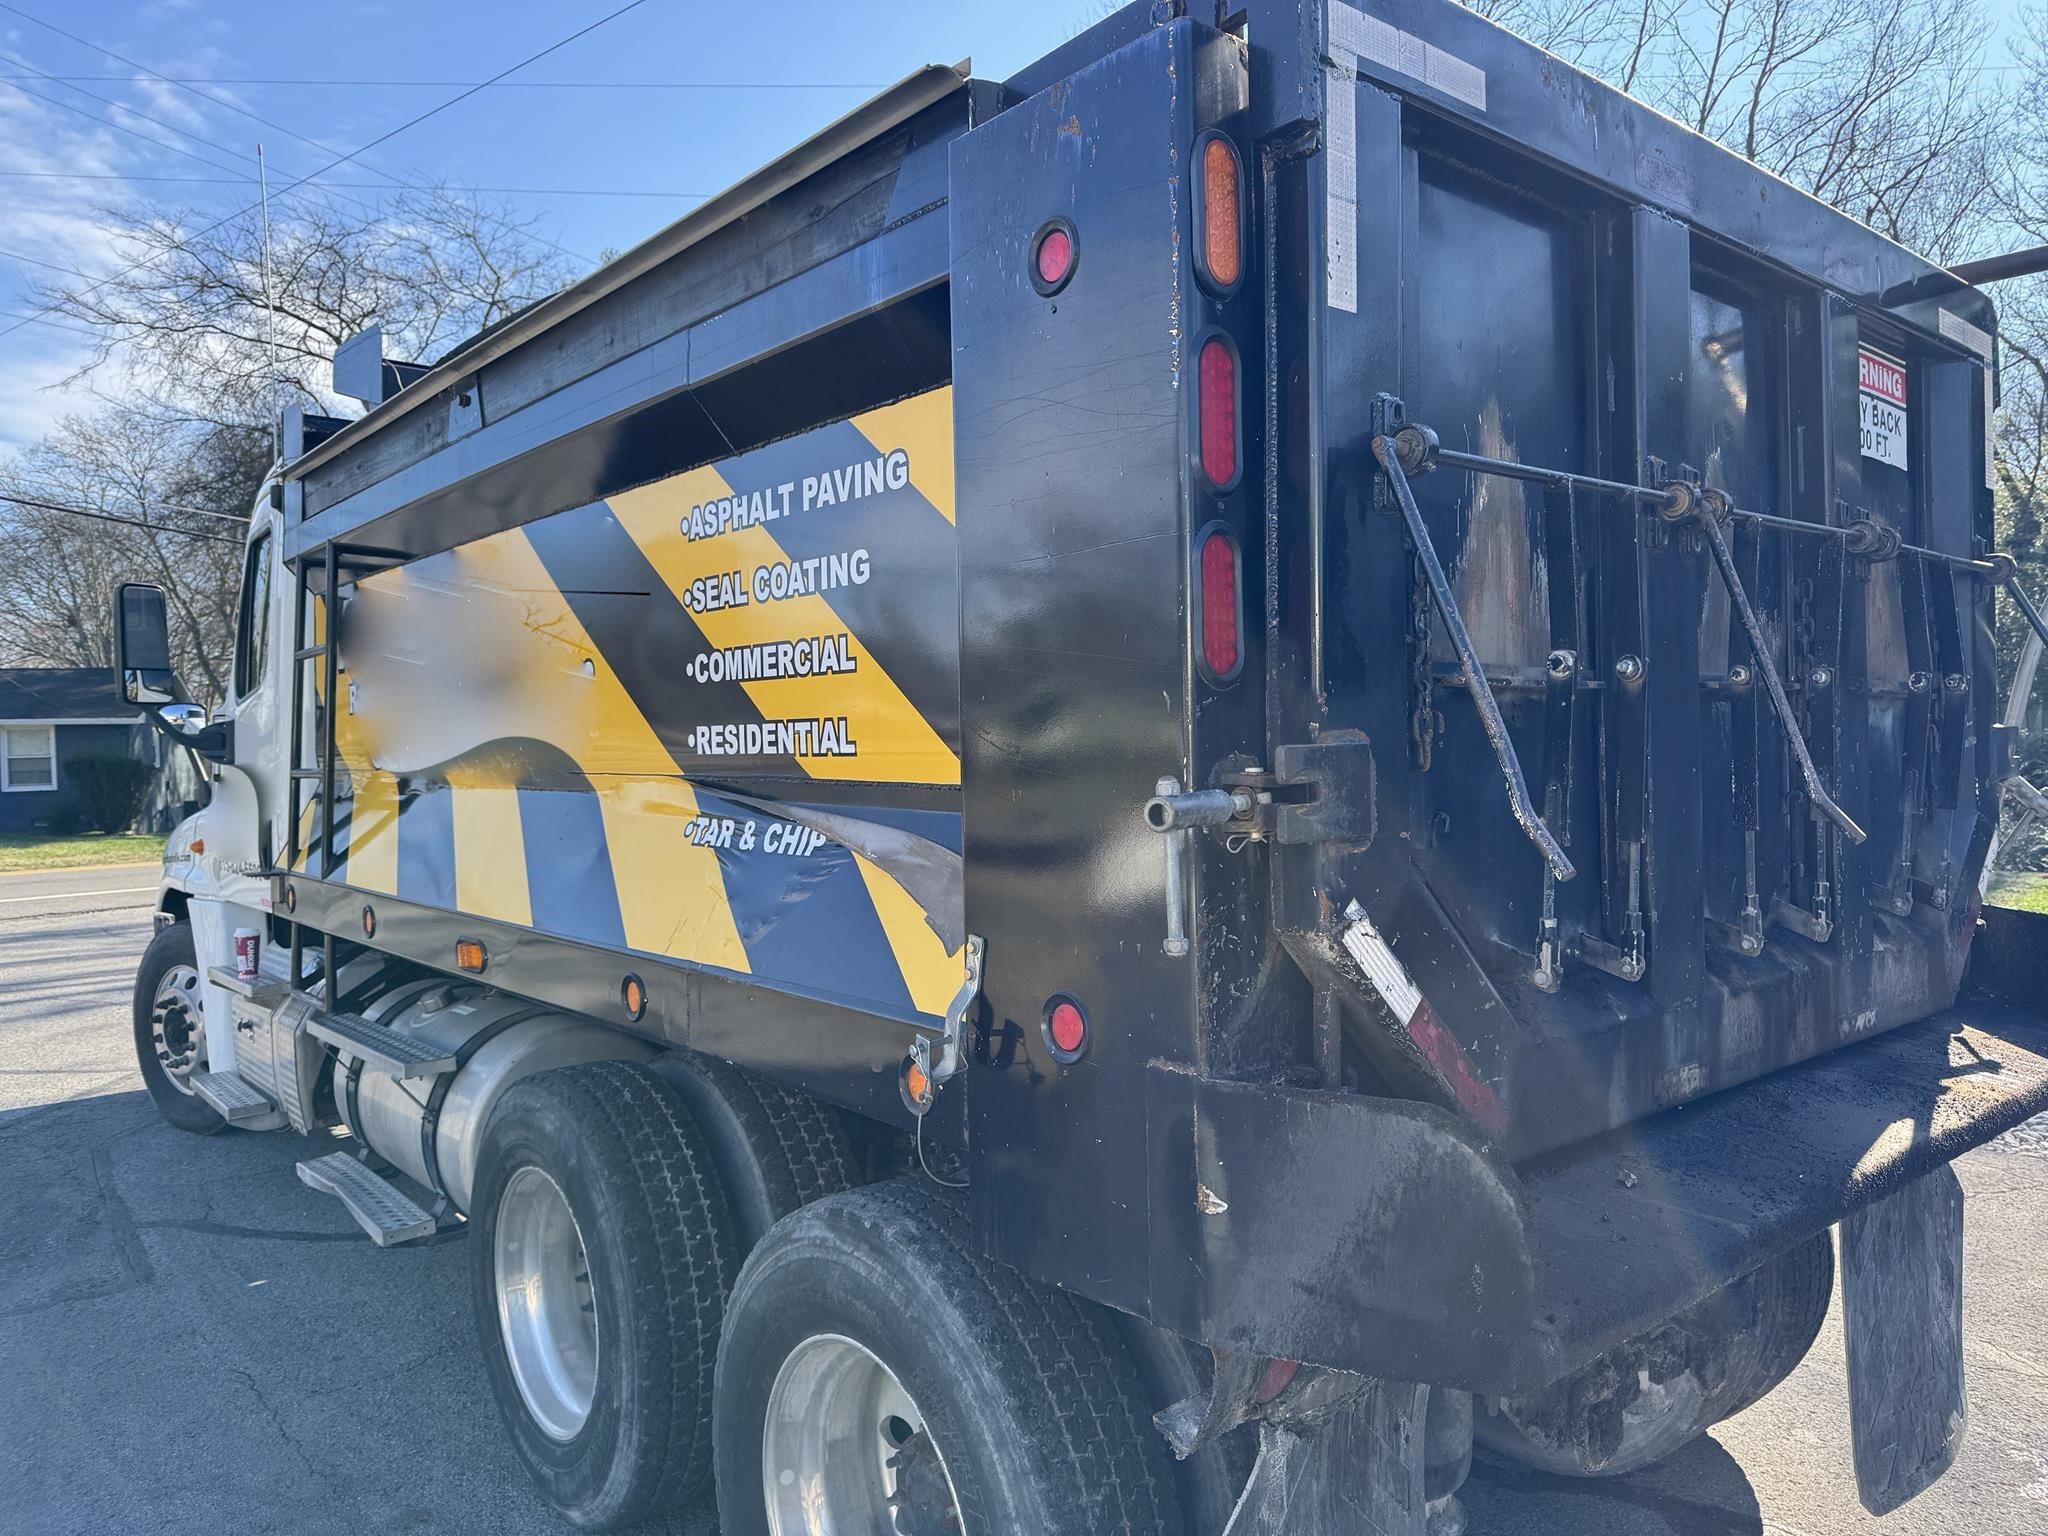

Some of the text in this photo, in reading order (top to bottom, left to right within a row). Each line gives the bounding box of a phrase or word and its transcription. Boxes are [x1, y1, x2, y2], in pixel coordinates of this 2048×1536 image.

[1859, 357, 1902, 399] RNING
[1859, 401, 1902, 437] Y BACK
[1860, 428, 1872, 450] 00
[689, 450, 909, 540] ASPHALT PAVING
[691, 548, 871, 612] SEAL COATING
[694, 636, 857, 684] COMMERCIAL
[696, 719, 856, 755] RESIDENTIAL
[693, 816, 827, 857] TAR & CHIP
